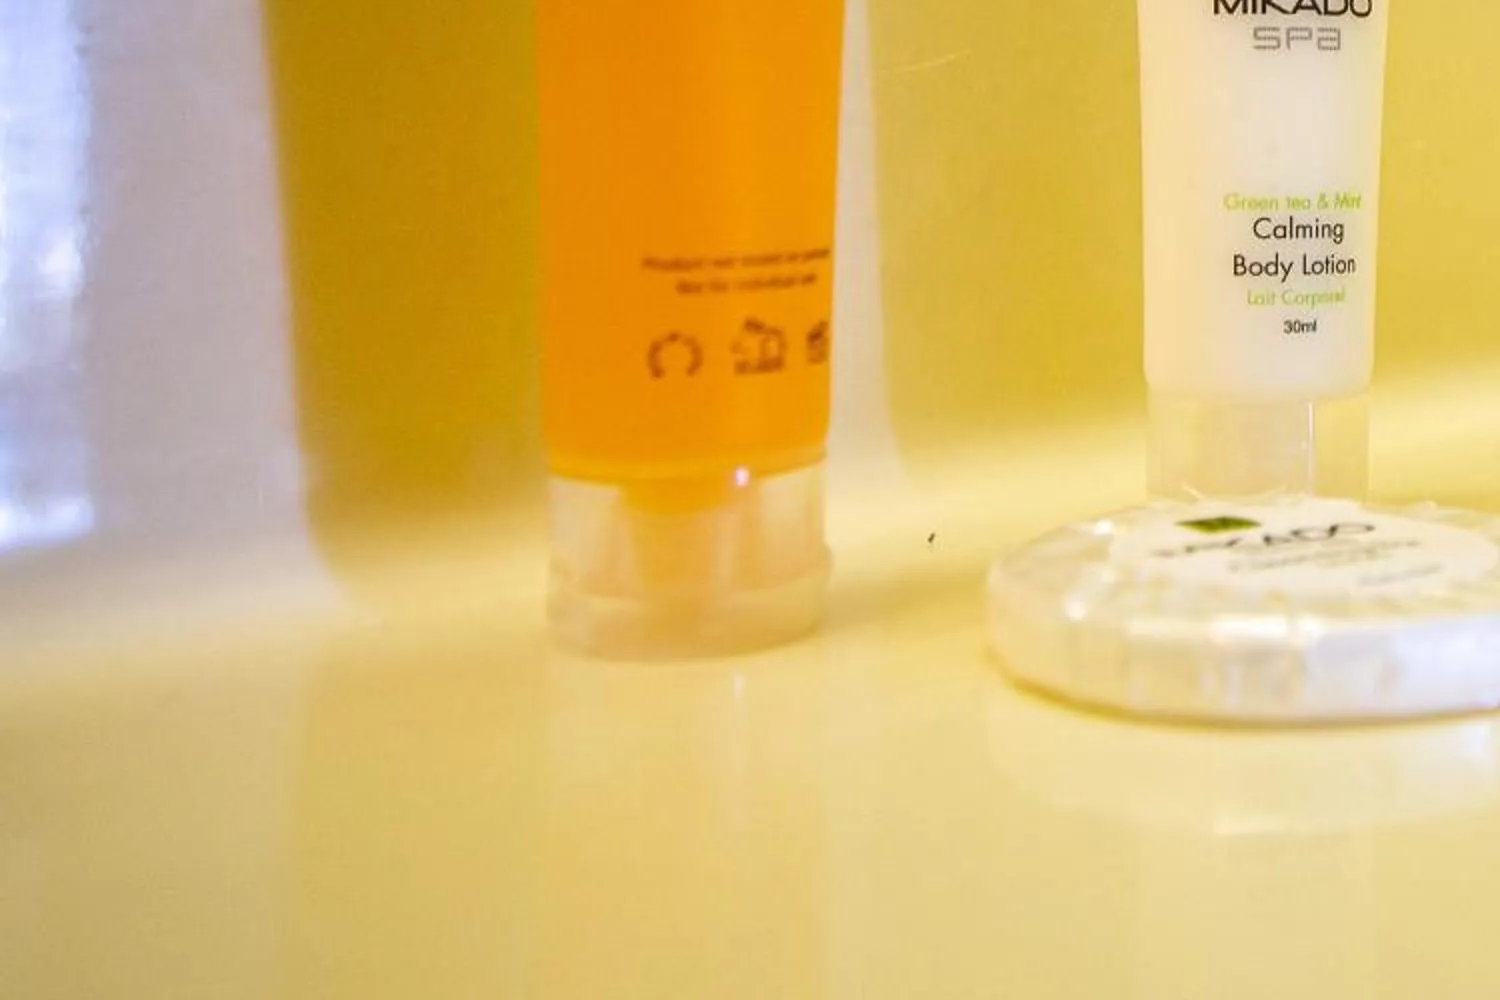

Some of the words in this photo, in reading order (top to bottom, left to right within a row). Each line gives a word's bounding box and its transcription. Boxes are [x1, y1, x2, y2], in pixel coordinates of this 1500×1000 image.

[1222, 192, 1279, 211] Green
[1286, 194, 1311, 211] tea
[1252, 215, 1345, 245] Calming
[1233, 252, 1294, 283] Body
[1302, 253, 1357, 276] Lotion
[1246, 288, 1276, 306] Lait
[1282, 318, 1318, 335] 30ml
